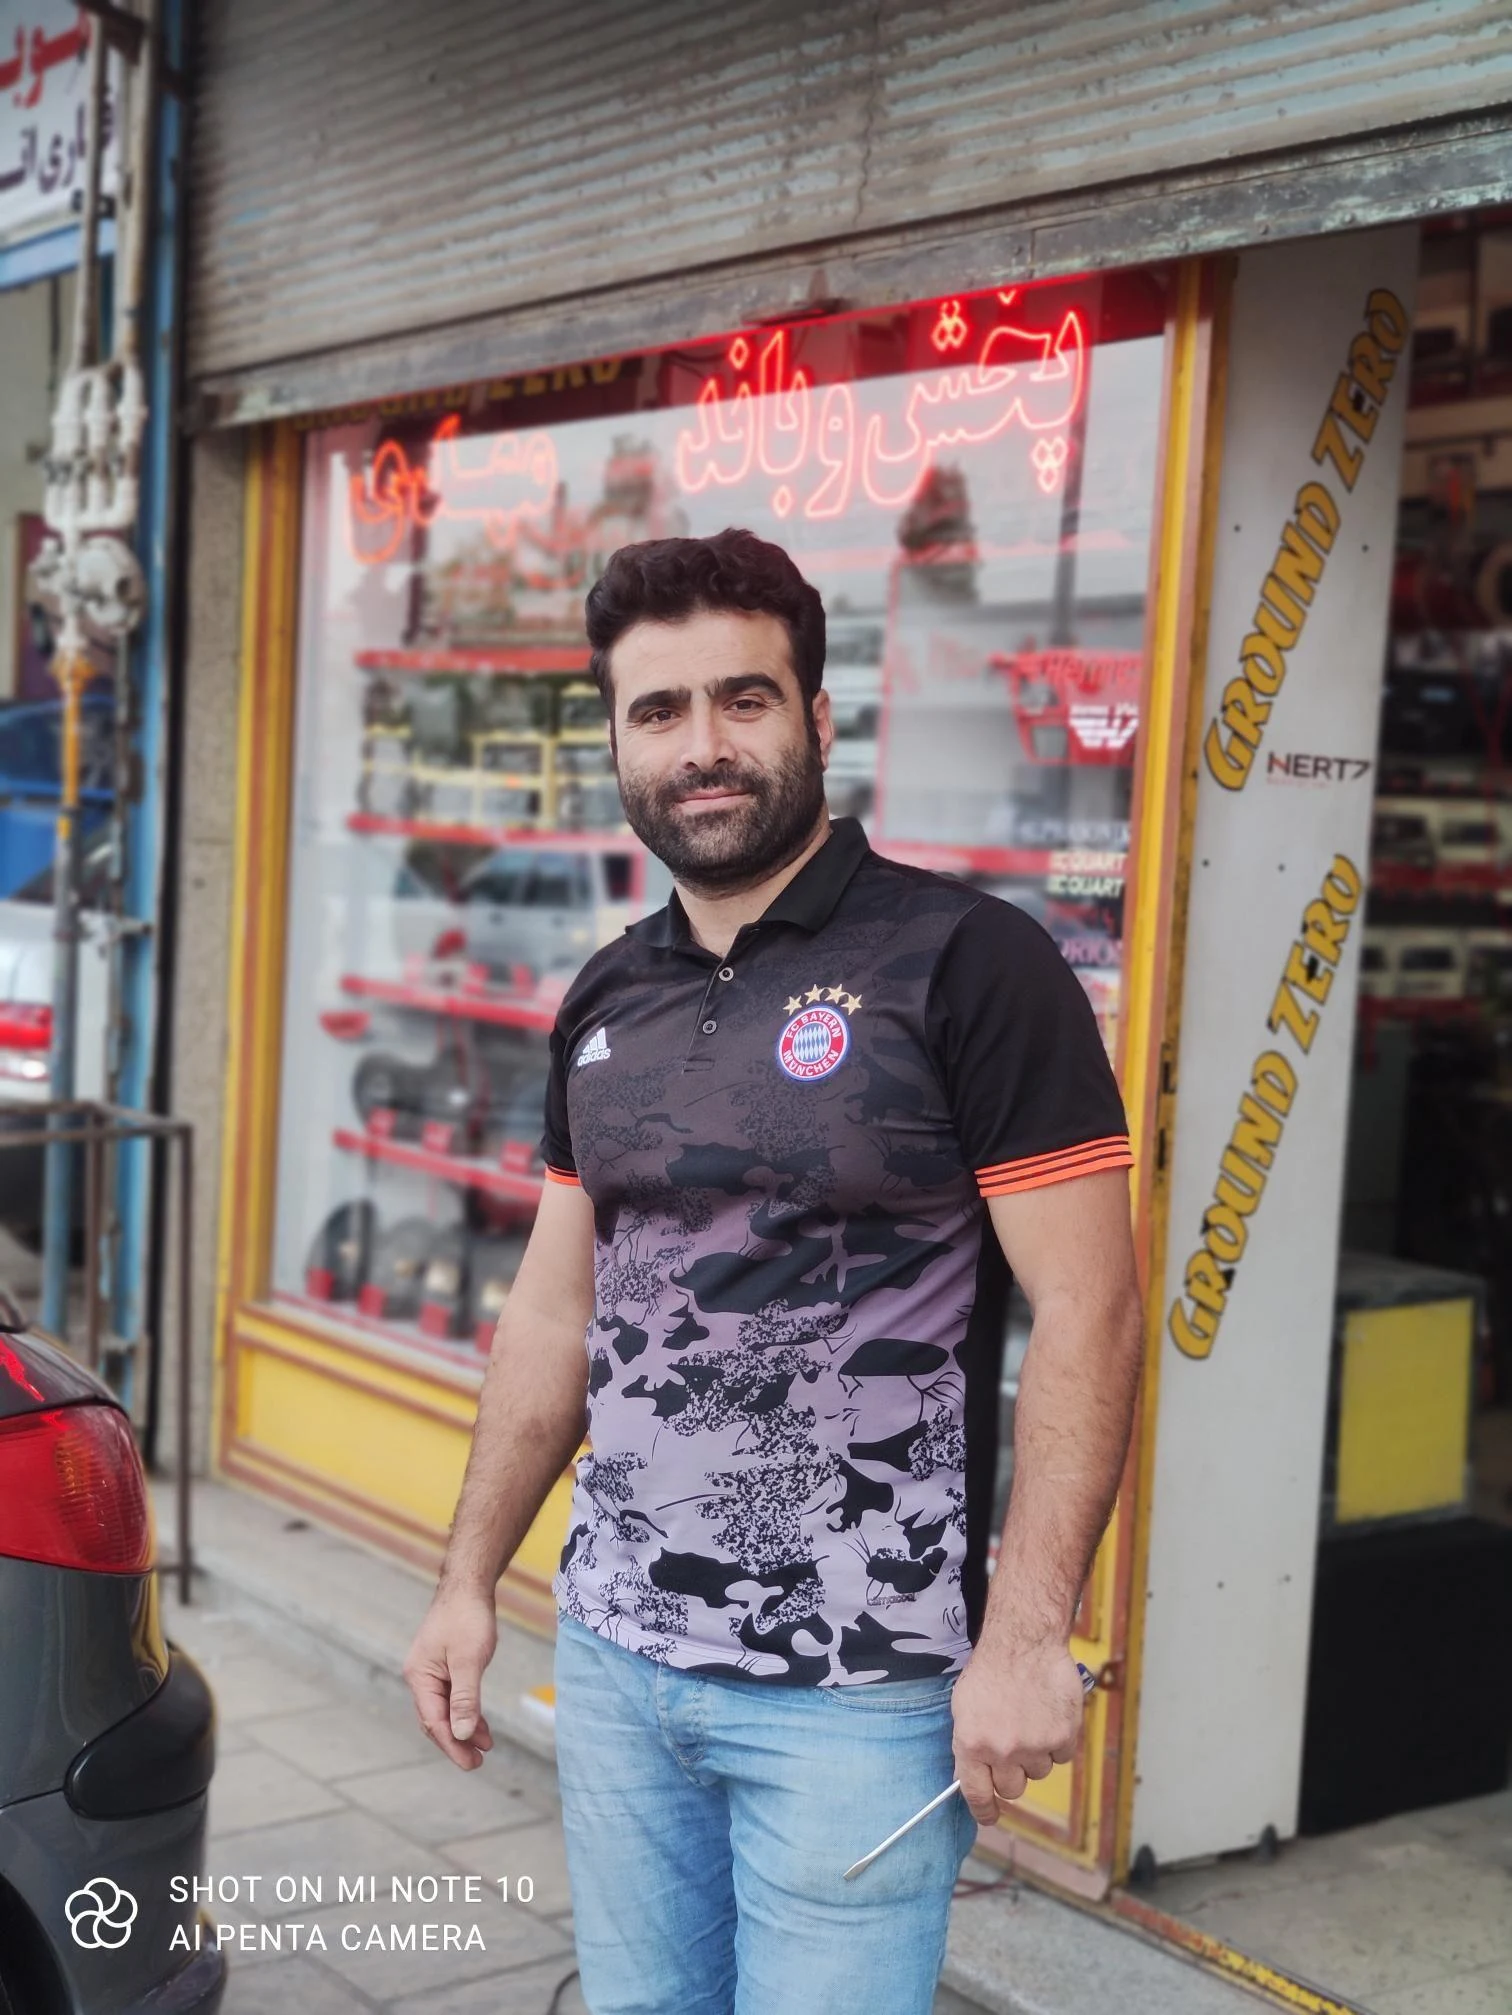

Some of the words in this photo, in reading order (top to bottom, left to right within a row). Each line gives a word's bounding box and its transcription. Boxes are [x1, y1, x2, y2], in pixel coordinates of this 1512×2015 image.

[676, 329, 810, 518] باند
[860, 289, 1086, 507] پخش
[1204, 481, 1341, 791] GROUND
[1311, 287, 1409, 493] ZERO
[577, 1048, 611, 1067] adidas
[786, 1024, 800, 1038] FC
[801, 1012, 842, 1038] BAYERN
[1168, 1050, 1298, 1360] GROUND
[1267, 853, 1362, 1054] ZERO
